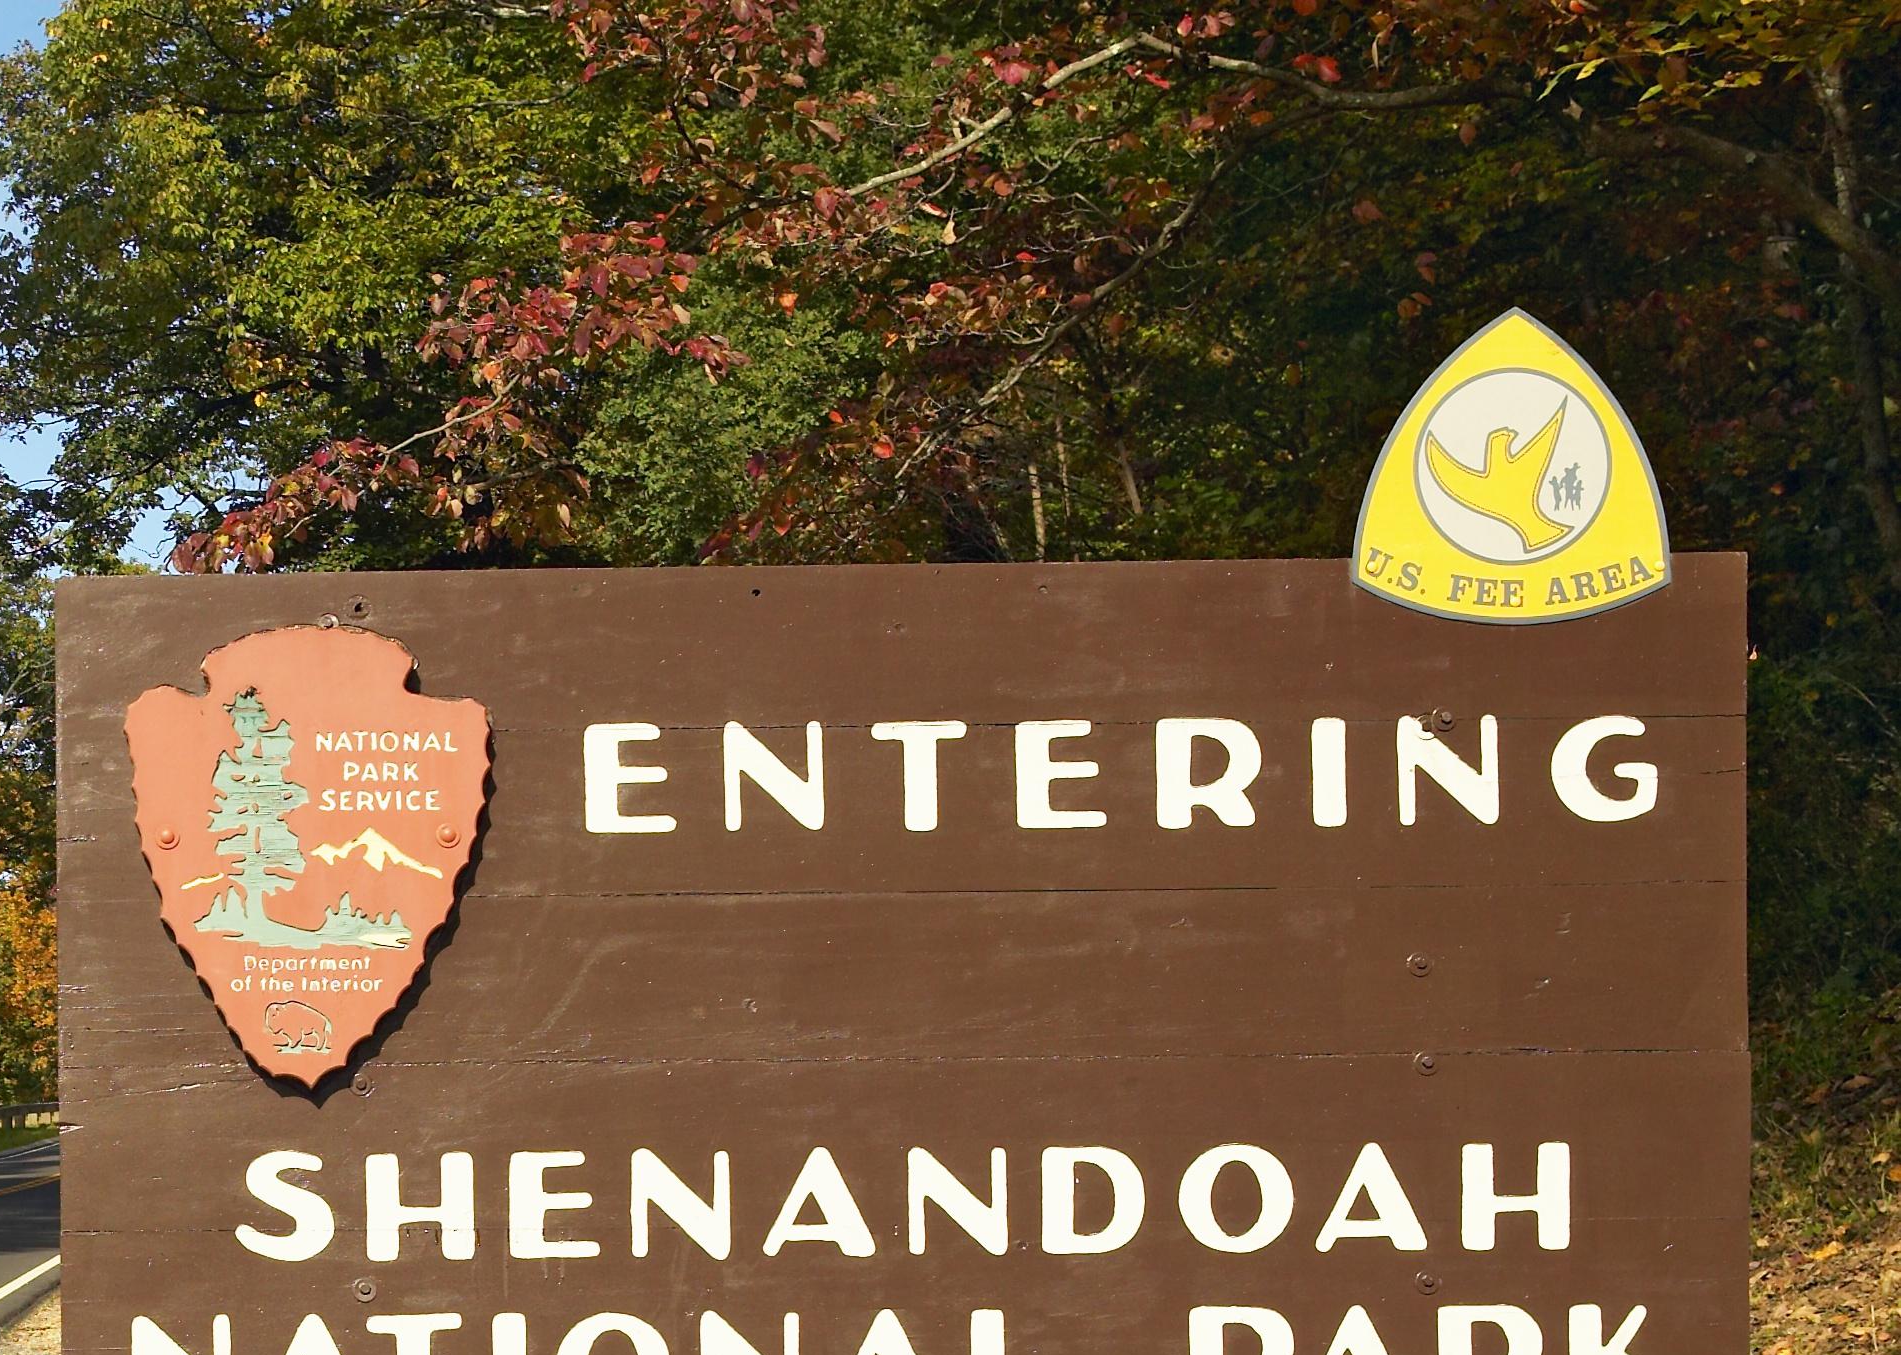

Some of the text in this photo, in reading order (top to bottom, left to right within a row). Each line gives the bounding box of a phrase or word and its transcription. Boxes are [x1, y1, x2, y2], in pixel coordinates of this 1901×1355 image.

[1446, 574, 1524, 608] FEE
[1545, 556, 1655, 606] AREA
[315, 731, 458, 753] NATIONAL
[343, 761, 420, 783] PARK
[583, 714, 1660, 834] ENTERING
[318, 789, 442, 812] SERVICE
[243, 955, 371, 976] Department
[230, 975, 383, 994] of the Interior
[234, 1142, 1572, 1263] SHENANDOAH
